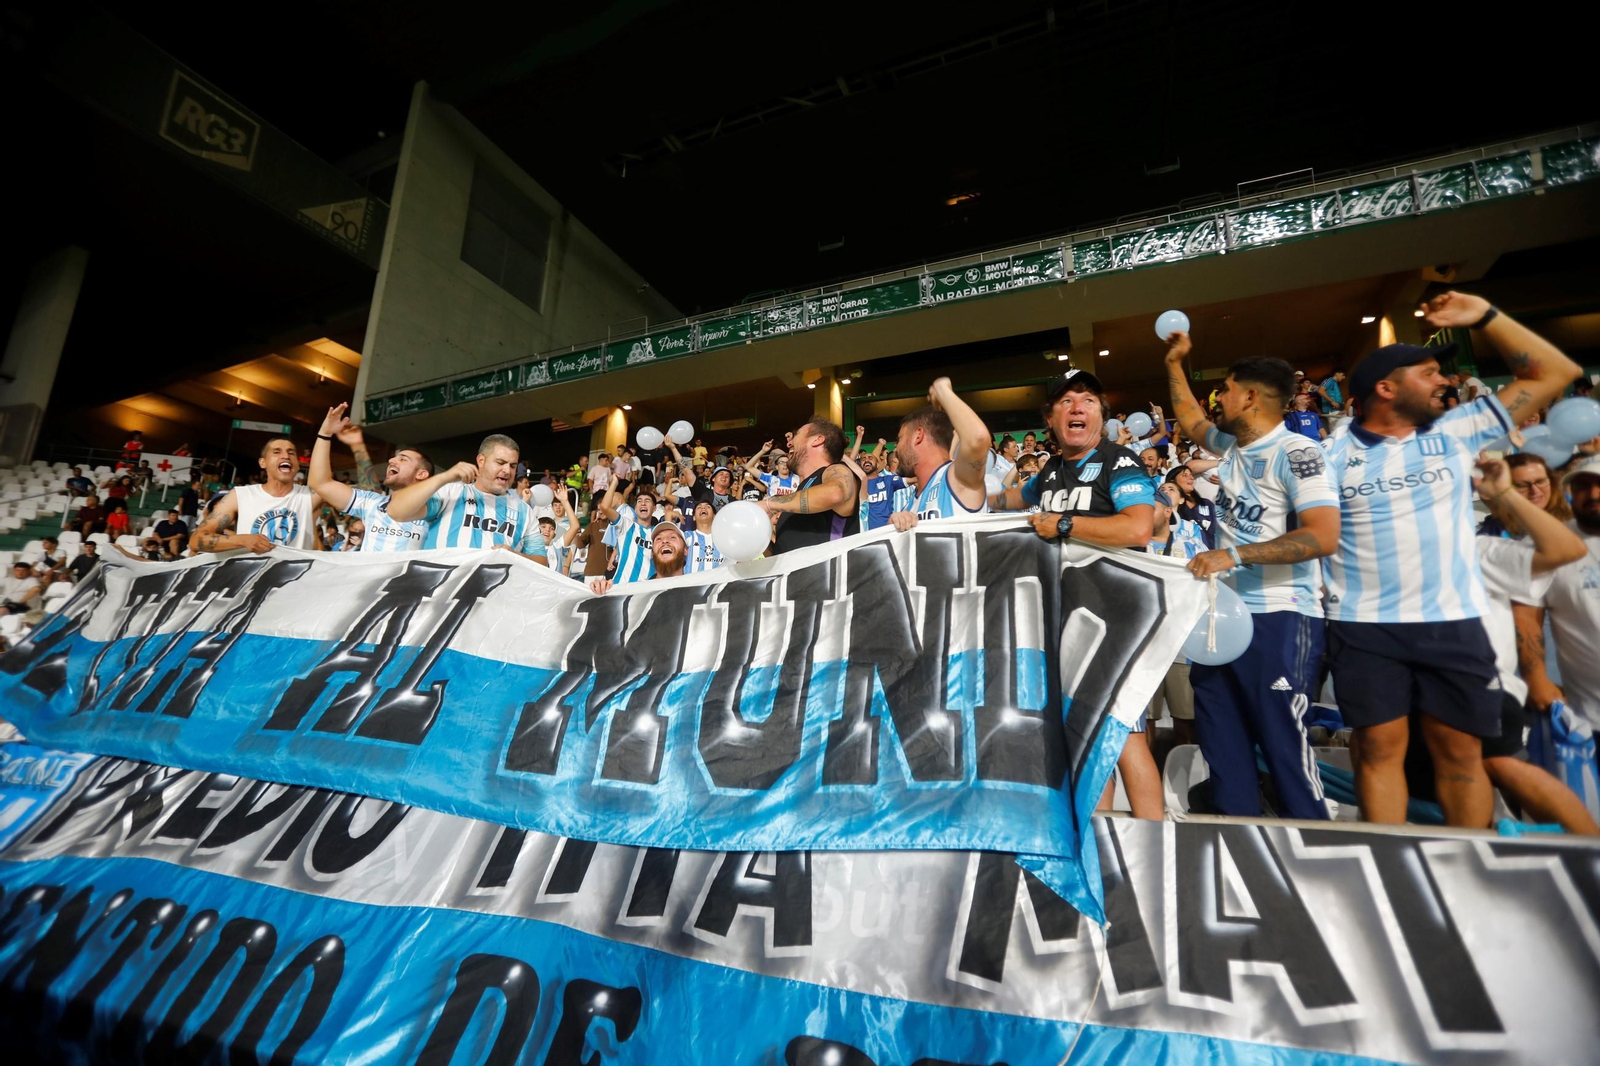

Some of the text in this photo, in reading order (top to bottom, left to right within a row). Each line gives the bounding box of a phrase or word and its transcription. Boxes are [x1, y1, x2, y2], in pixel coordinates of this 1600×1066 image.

[173, 96, 247, 153] RG3
[331, 211, 359, 241] 90
[985, 261, 1008, 272] BMW
[822, 295, 843, 306] BMW
[576, 354, 613, 372] Barquro
[1340, 466, 1455, 501] betsson
[1040, 486, 1093, 513] RCA
[370, 525, 421, 541] betsson
[463, 513, 515, 538] RCA
[262, 560, 513, 746] AL
